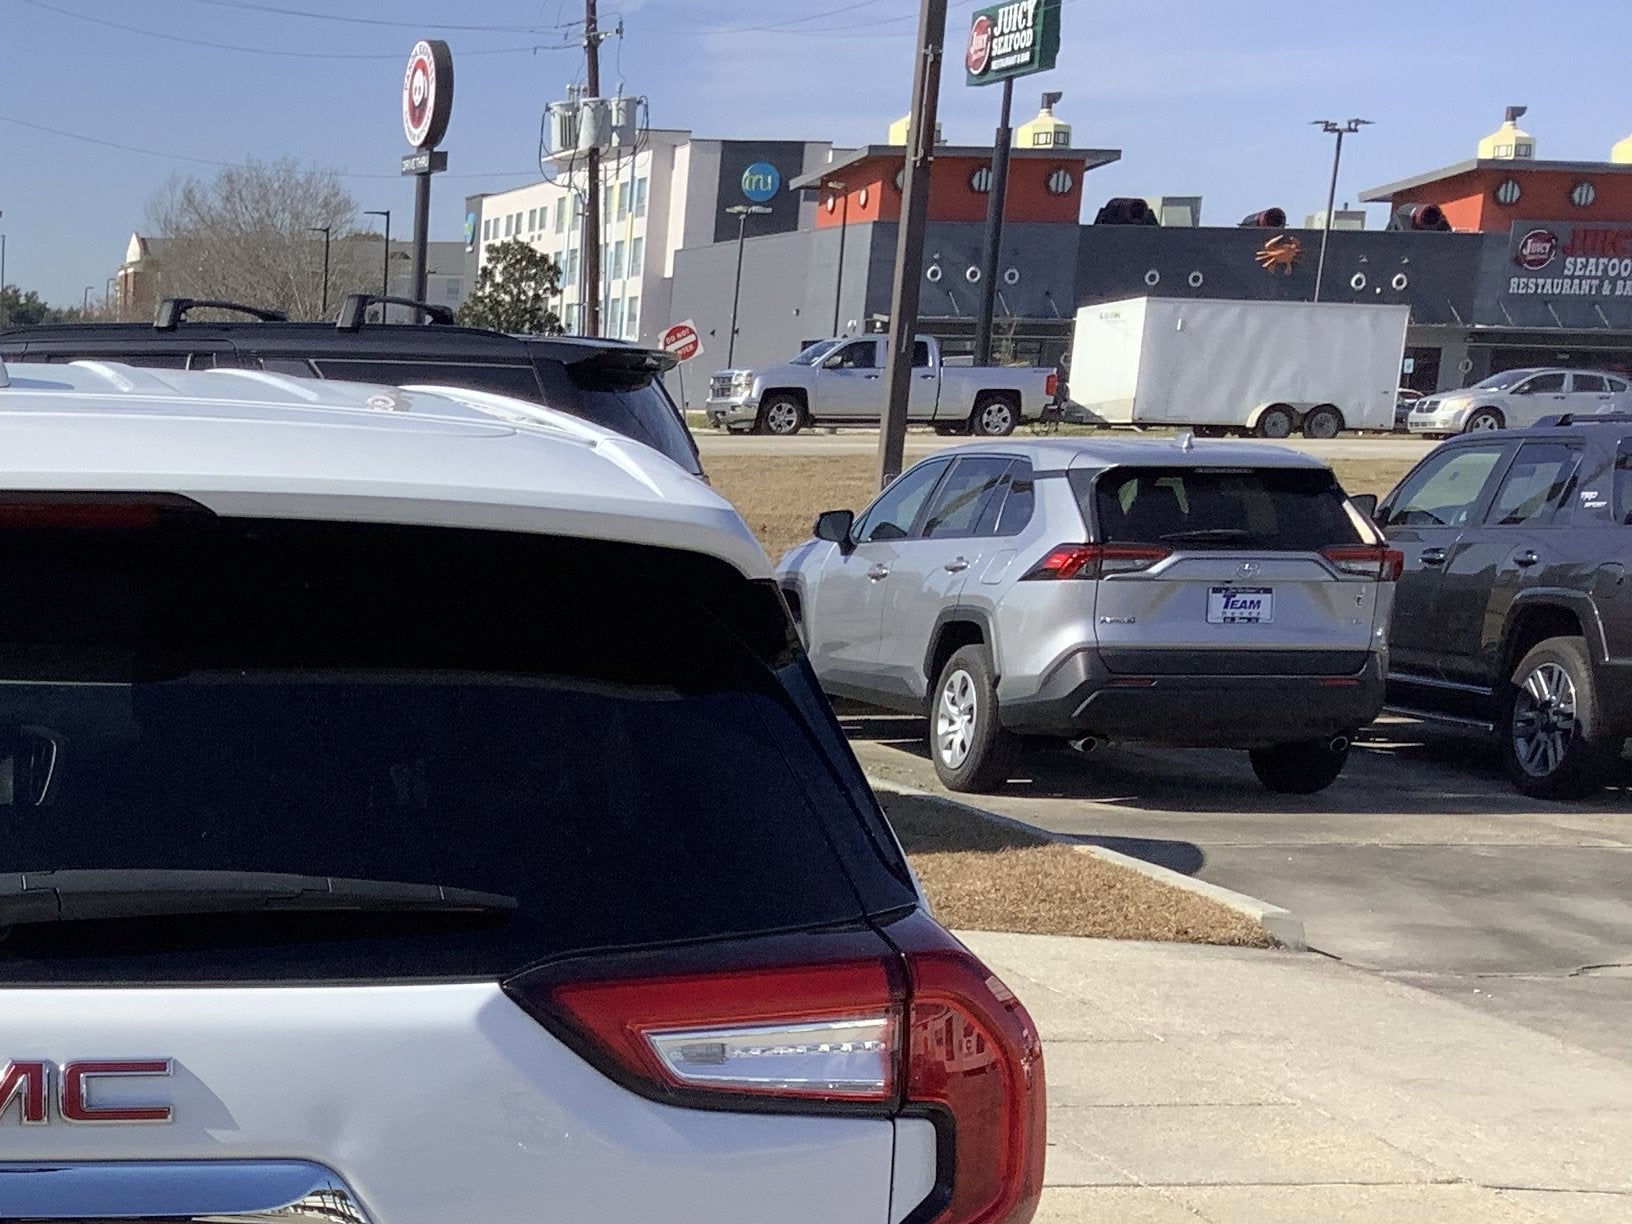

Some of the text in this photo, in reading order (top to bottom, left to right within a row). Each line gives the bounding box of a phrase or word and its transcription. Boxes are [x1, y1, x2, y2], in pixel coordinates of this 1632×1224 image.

[993, 0, 1037, 36] JUICY
[991, 28, 1033, 56] SEAFOOD
[1562, 229, 1632, 256] JUIC
[1563, 256, 1632, 277] SEAFOO
[1509, 277, 1632, 297] RESTAURANT & BA
[677, 328, 690, 338] NOT
[674, 344, 695, 354] NTER
[1223, 592, 1261, 609] TEAM
